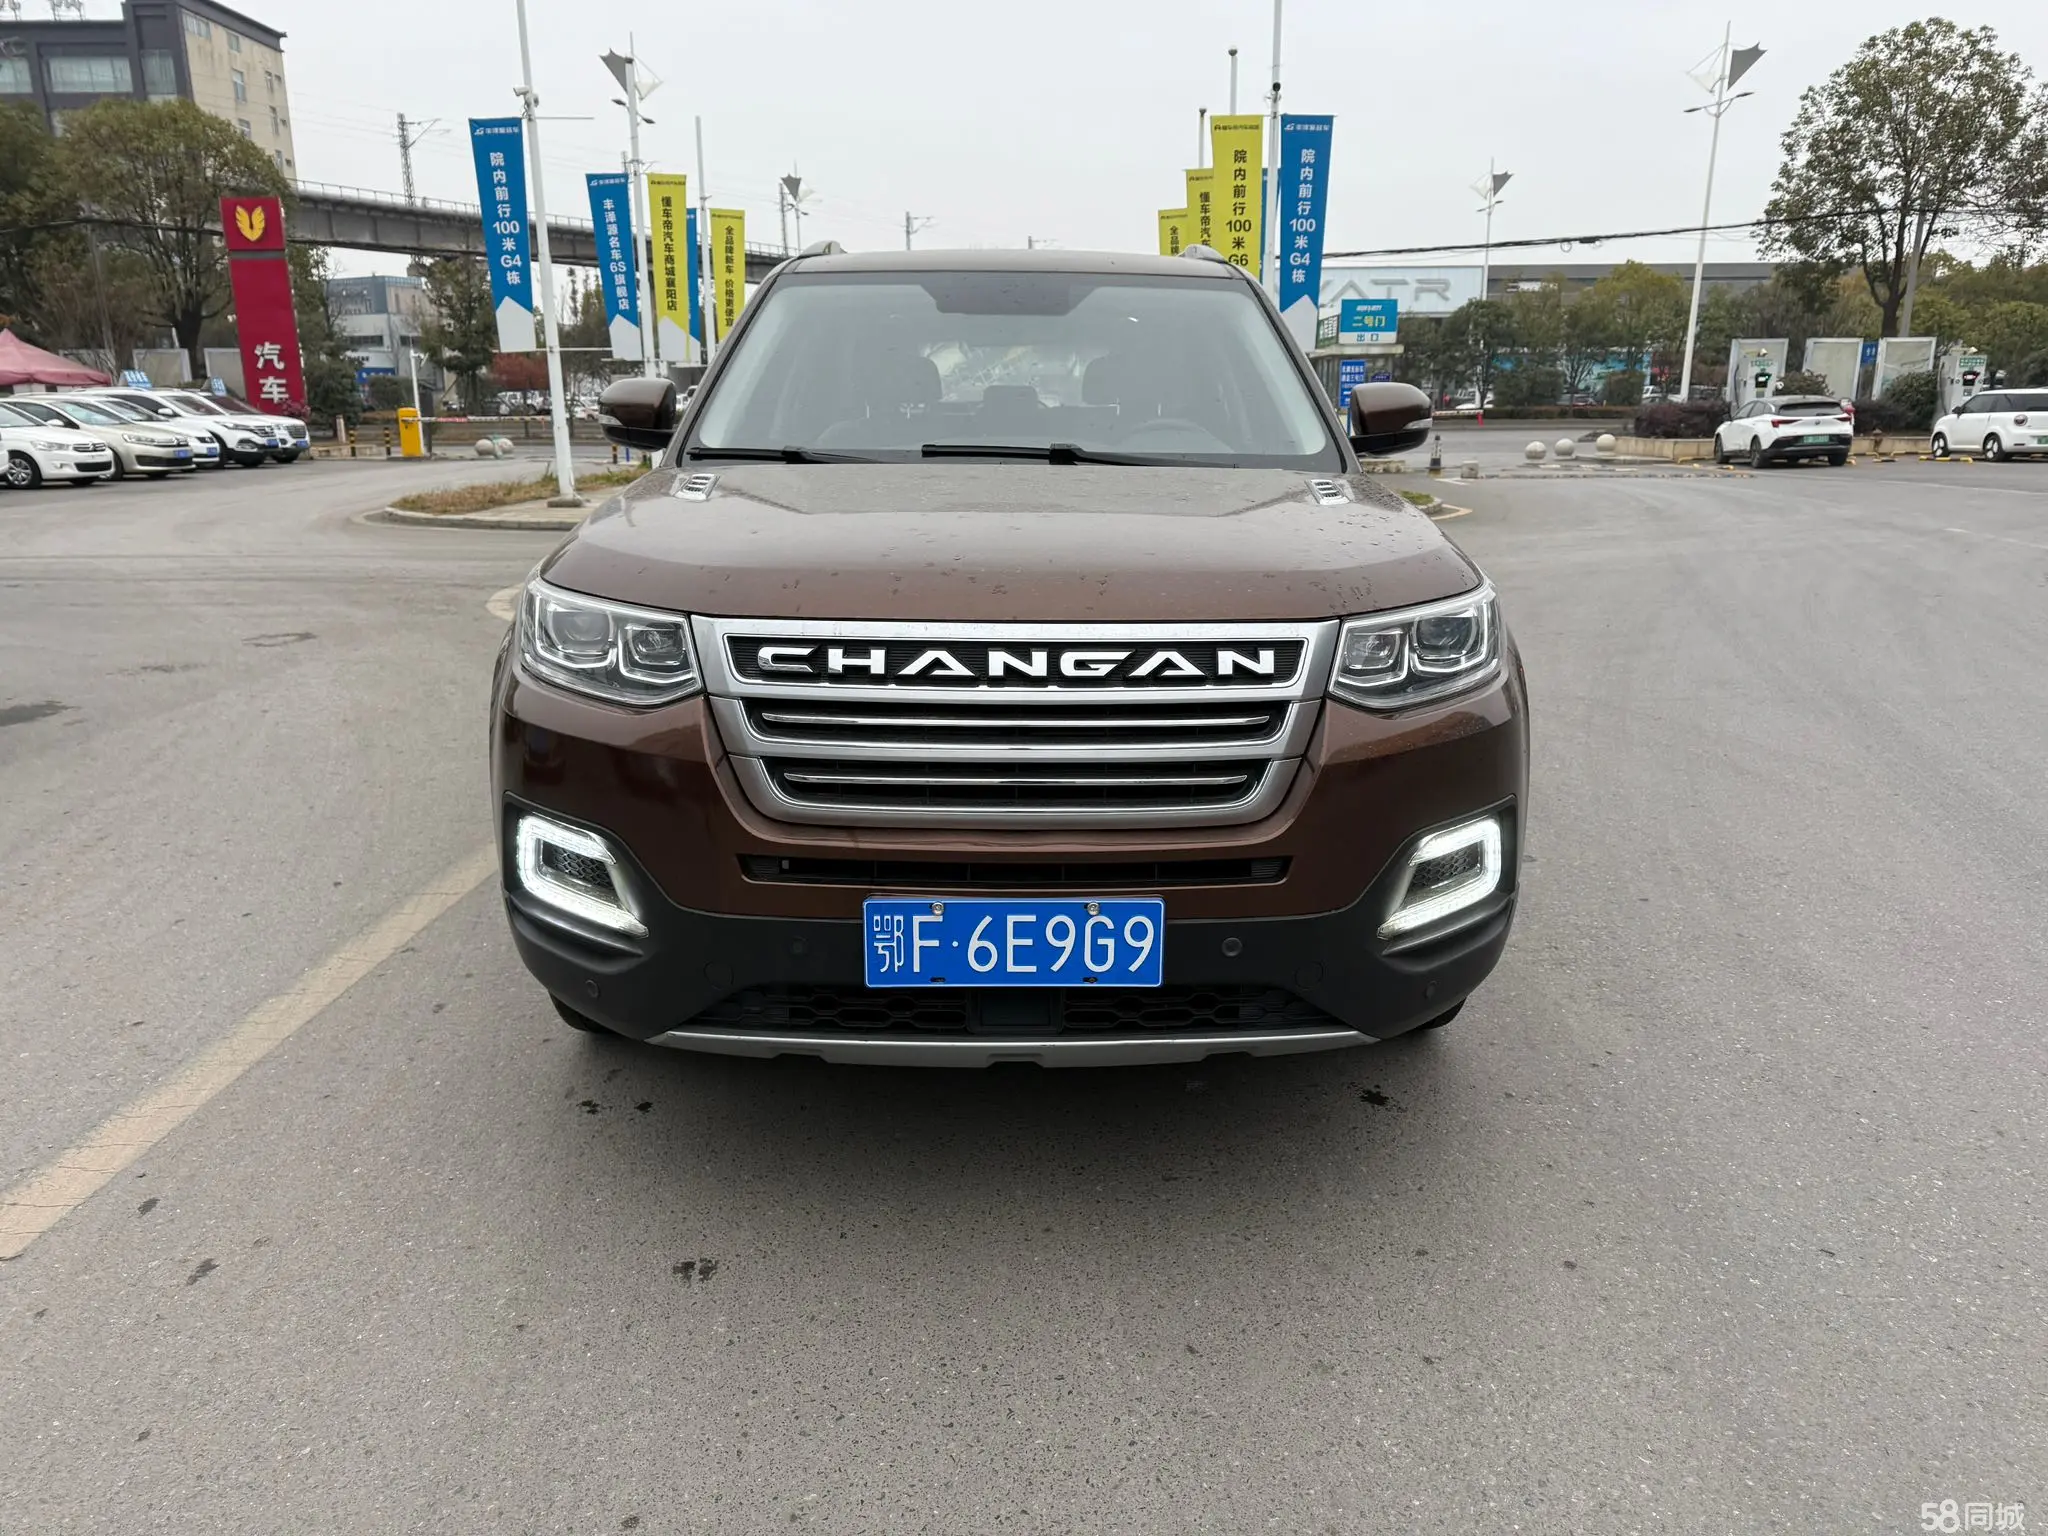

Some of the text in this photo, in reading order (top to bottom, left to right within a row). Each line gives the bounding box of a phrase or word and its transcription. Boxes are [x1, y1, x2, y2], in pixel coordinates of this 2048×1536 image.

[489, 152, 521, 285] 院内前行100米G4栋
[1289, 149, 1316, 284] 院内前行100米G4栋
[255, 341, 290, 404] 汽车
[757, 645, 1276, 678] CHANGAN
